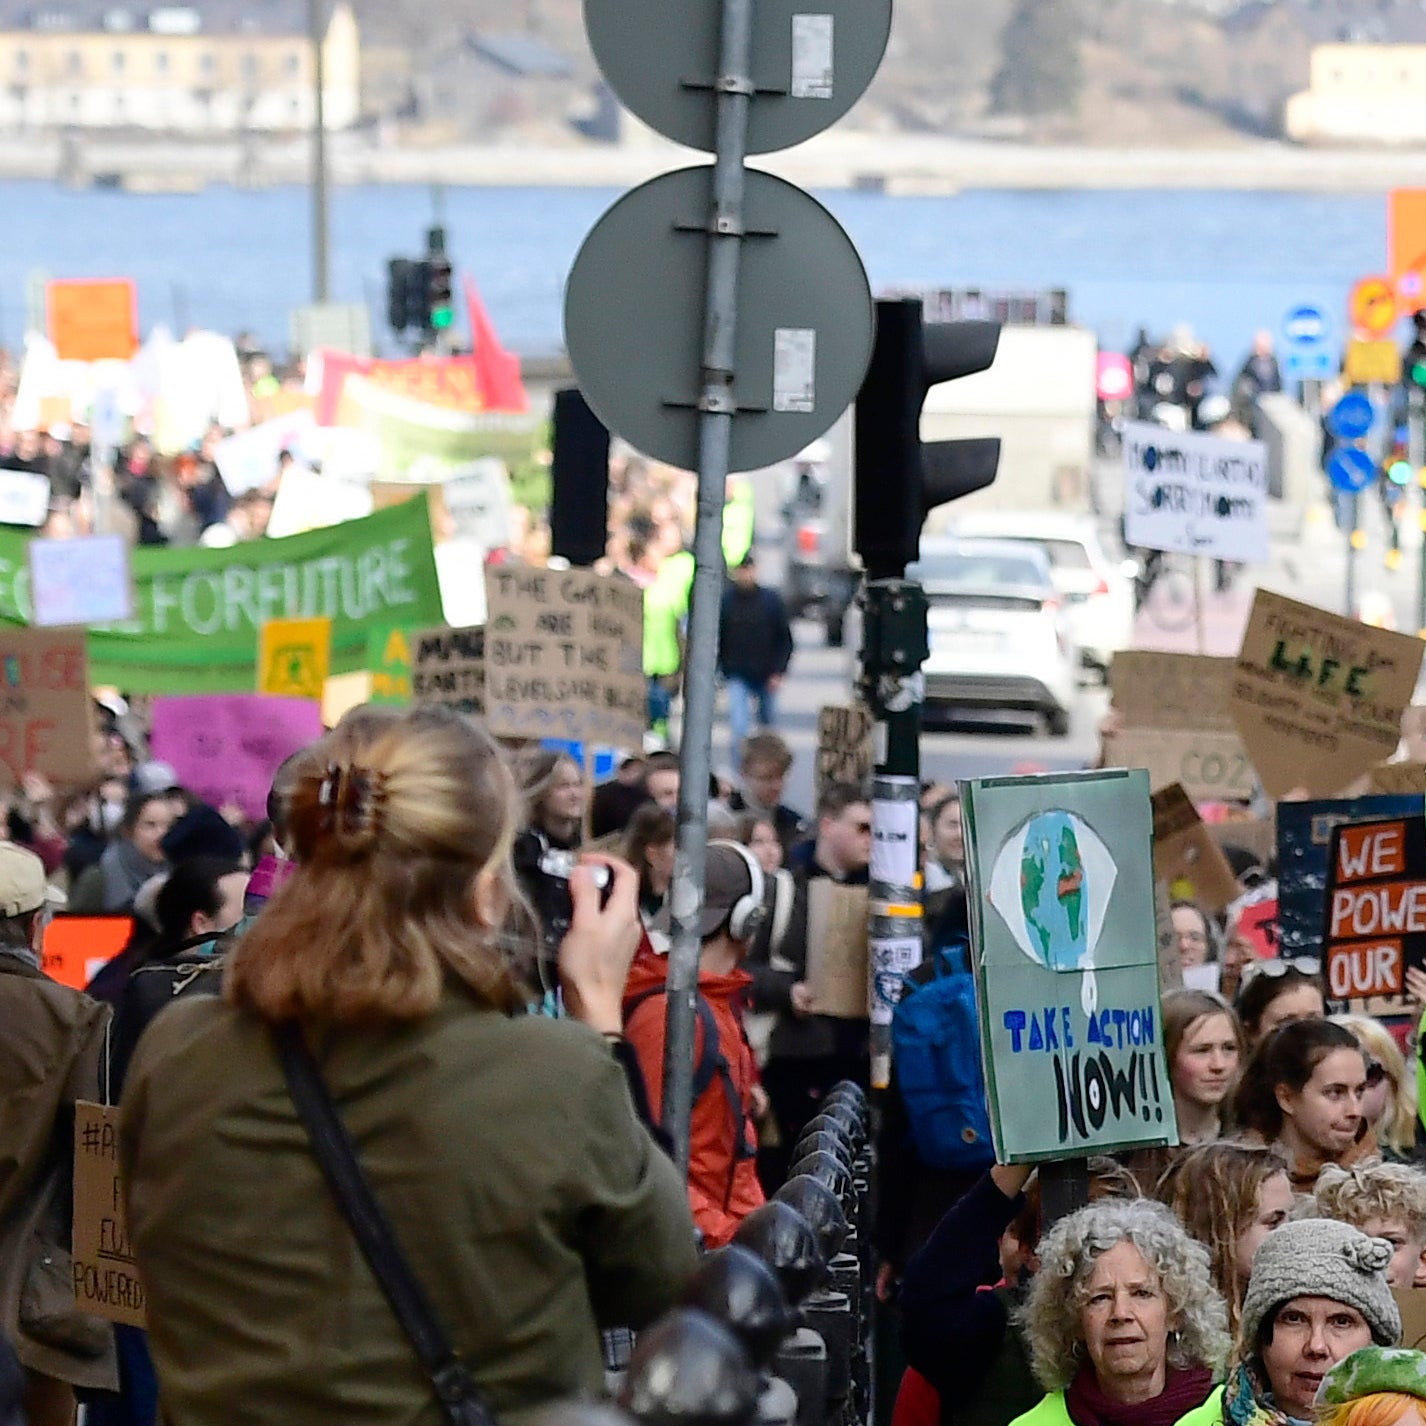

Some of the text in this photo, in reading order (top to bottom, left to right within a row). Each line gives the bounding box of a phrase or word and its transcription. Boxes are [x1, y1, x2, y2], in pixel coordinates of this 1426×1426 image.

[1338, 831, 1399, 878] WE
[1329, 946, 1398, 996] OUR
[1004, 1005, 1154, 1053] TAKE ACTION
[1053, 1050, 1162, 1144] NOW!!
[74, 1261, 143, 1317] POWERED
